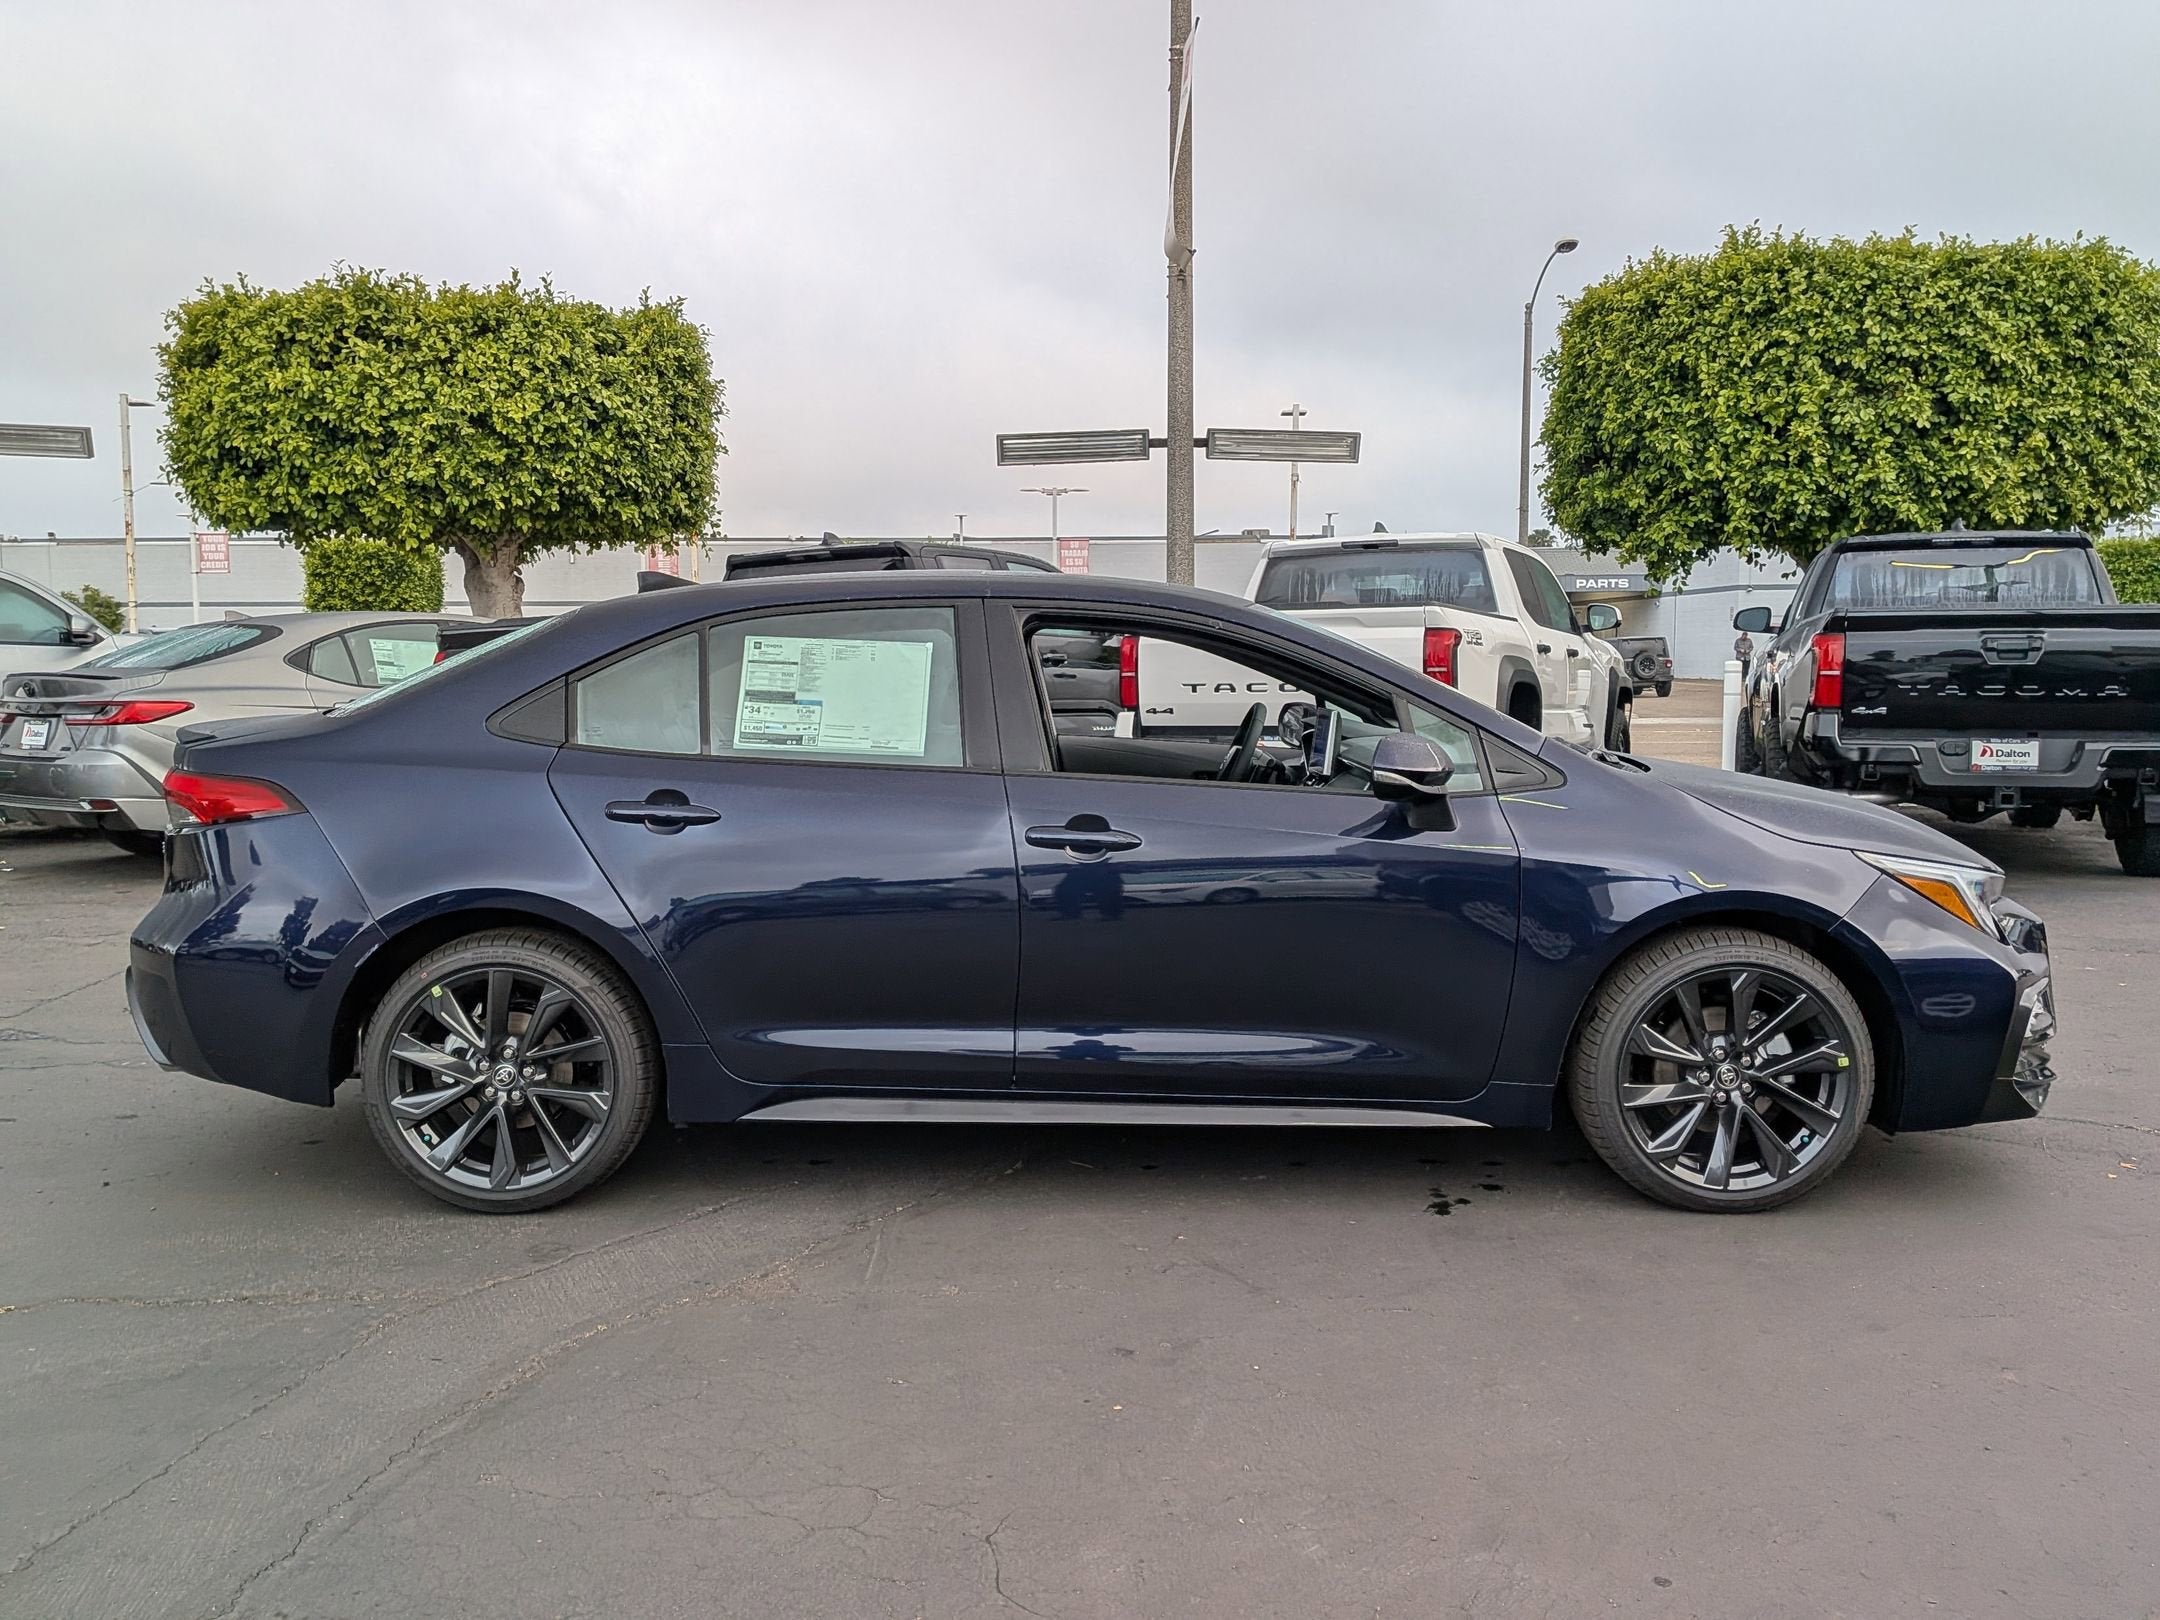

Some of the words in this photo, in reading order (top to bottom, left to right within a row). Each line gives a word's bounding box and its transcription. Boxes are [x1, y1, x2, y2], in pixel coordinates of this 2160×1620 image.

[200, 561, 228, 569] CREDIT
[1576, 578, 1629, 589] PARTS
[1181, 682, 1301, 693] TACO
[1898, 685, 2127, 696] TACOMA
[748, 705, 761, 714] 34
[1995, 749, 2031, 758] Dalton
